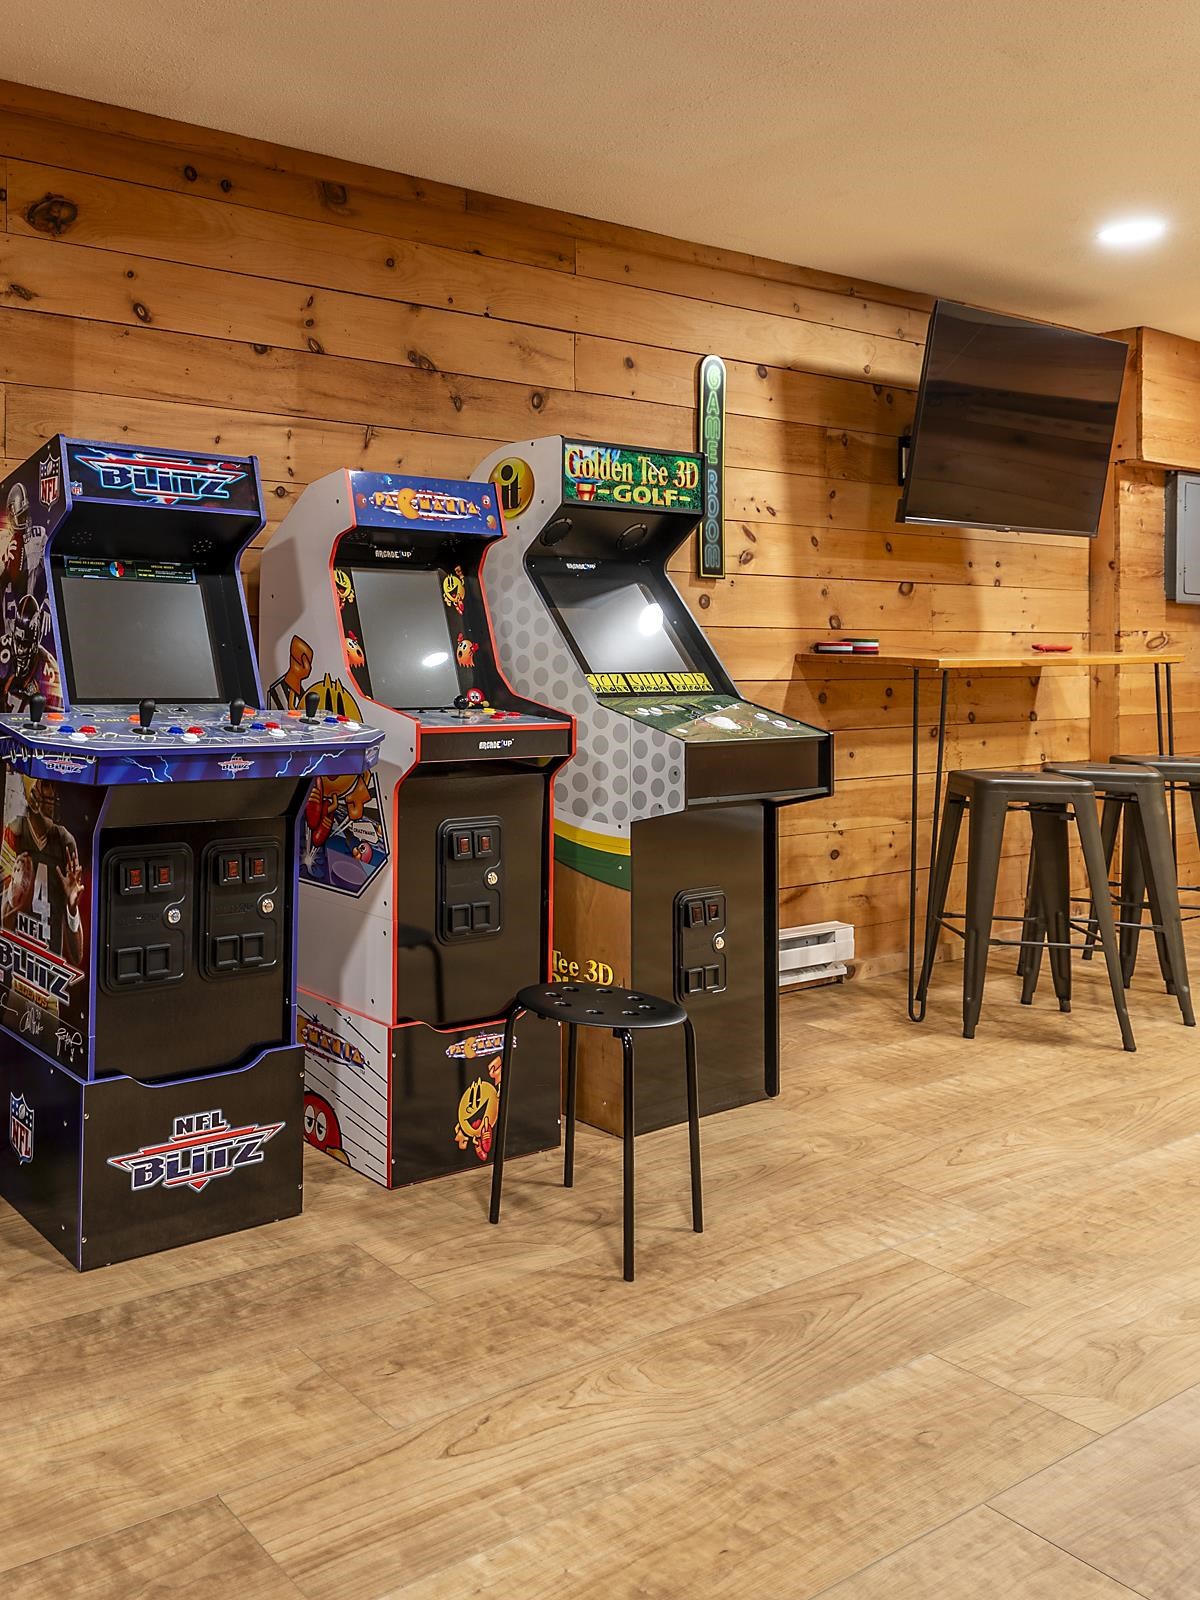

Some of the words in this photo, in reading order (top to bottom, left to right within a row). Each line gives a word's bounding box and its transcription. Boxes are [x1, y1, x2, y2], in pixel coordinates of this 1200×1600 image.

[704, 365, 721, 464] GAME
[100, 464, 230, 499] BLITZ
[565, 448, 634, 484] Golden
[638, 456, 668, 486] Tee
[672, 460, 699, 489] 3D
[41, 477, 58, 502] NFL
[705, 469, 721, 568] ROOM
[17, 912, 50, 942] NFL
[584, 960, 614, 986] 3D
[10, 1121, 33, 1156] NFL
[176, 1110, 227, 1136] NFL
[130, 1132, 266, 1190] BLITZ
